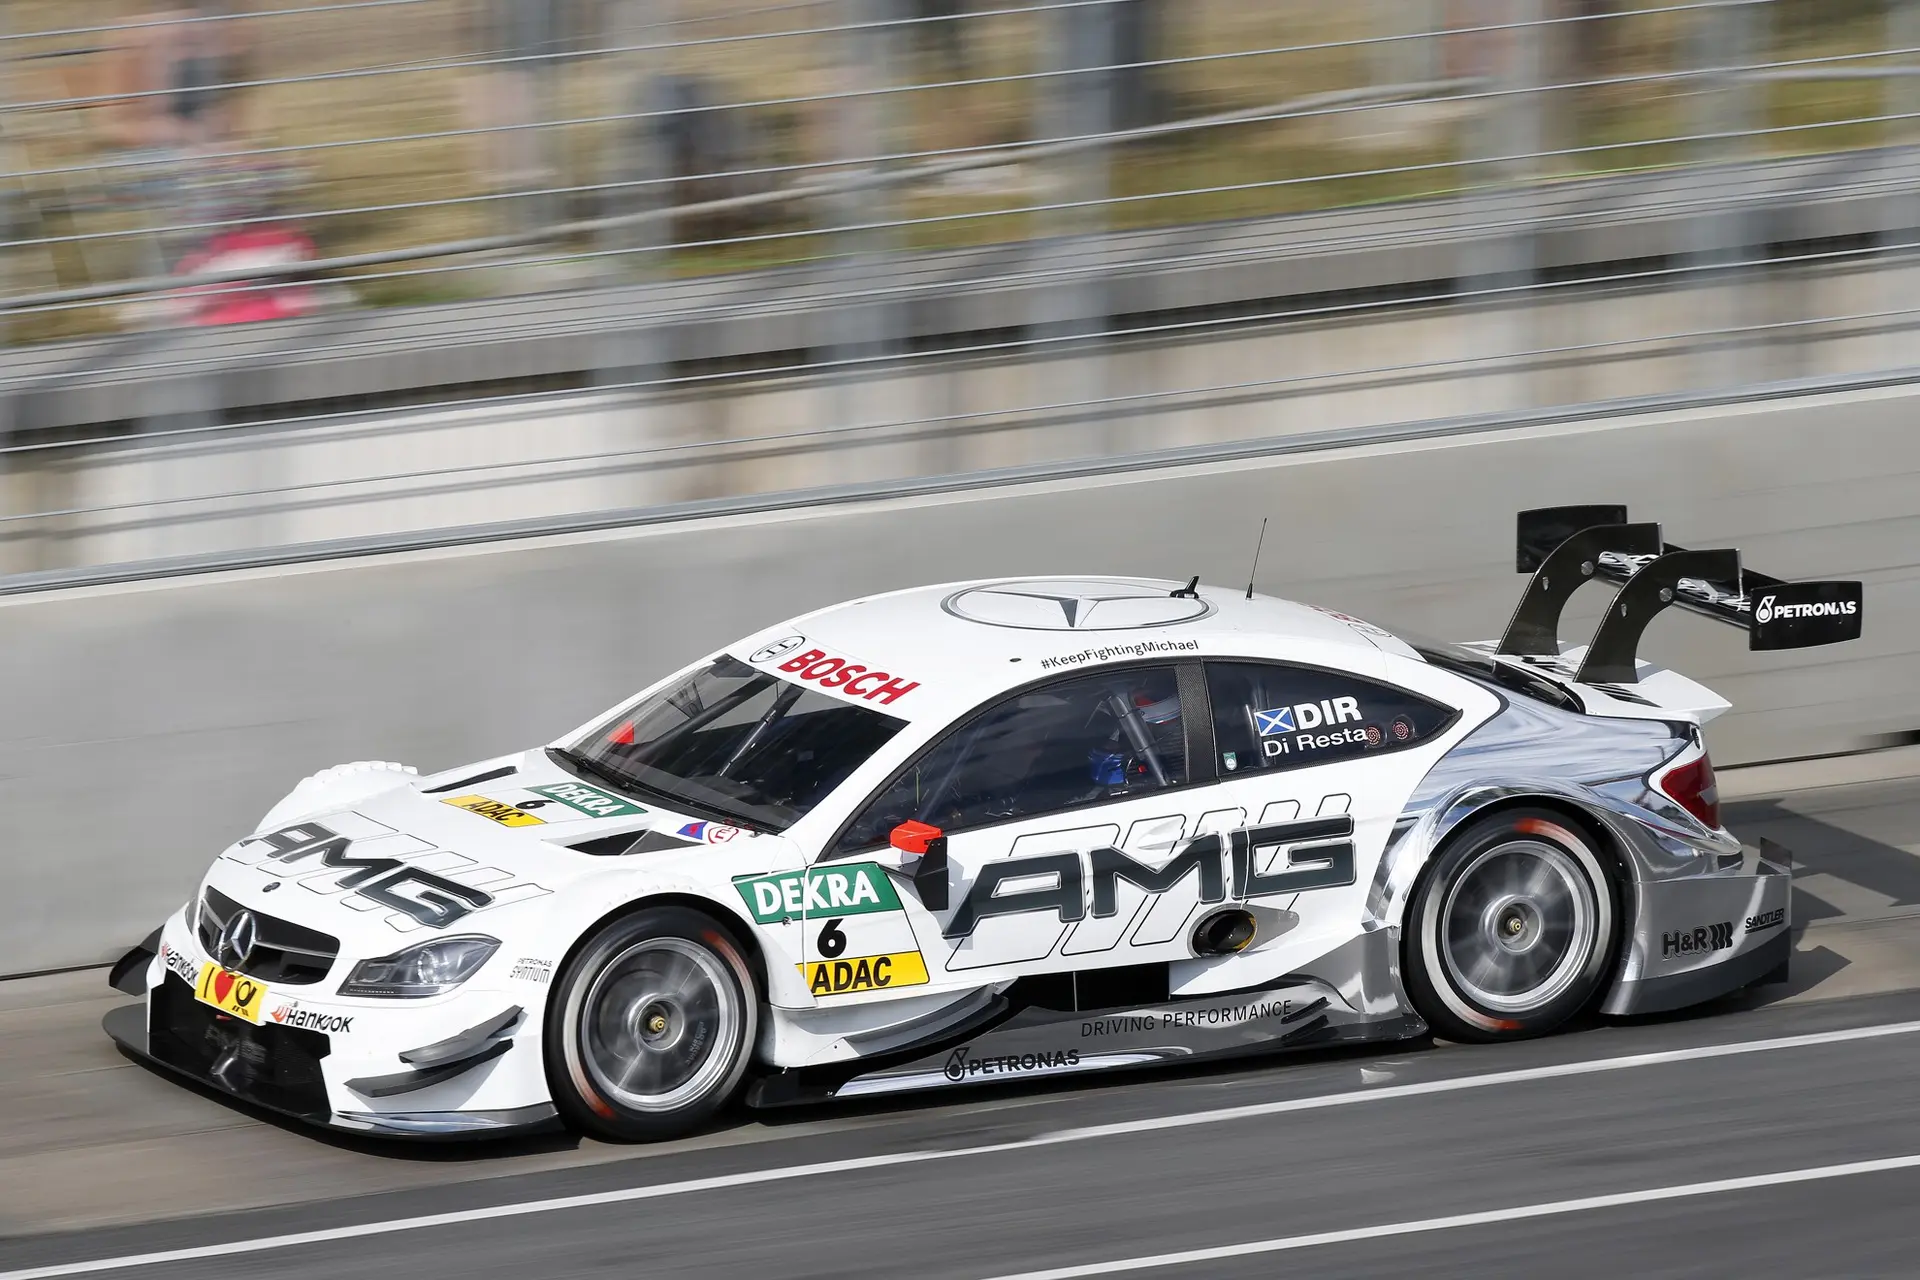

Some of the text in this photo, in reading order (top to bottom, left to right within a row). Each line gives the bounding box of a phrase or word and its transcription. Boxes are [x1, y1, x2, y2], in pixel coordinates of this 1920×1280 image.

[1774, 601, 1857, 619] PETRONAS
[1040, 639, 1199, 670] #KeepFightingMichael
[777, 648, 922, 705] BOSCH
[1293, 696, 1363, 730] DIR
[1263, 728, 1368, 757] Di Resta
[463, 800, 525, 821] ADAC
[515, 800, 557, 809] 6
[542, 784, 625, 816] DEKRA
[238, 821, 496, 929] AMG
[941, 813, 1357, 940] AMG
[753, 870, 881, 916] DEKRA
[1745, 908, 1785, 929] SANDTLER
[817, 918, 847, 958] 6
[1663, 927, 1708, 957] H&R
[811, 956, 892, 994] ADAC
[1081, 1000, 1292, 1038] DRIVING PERFORMANCE
[969, 1049, 1080, 1076] PETRONAS
